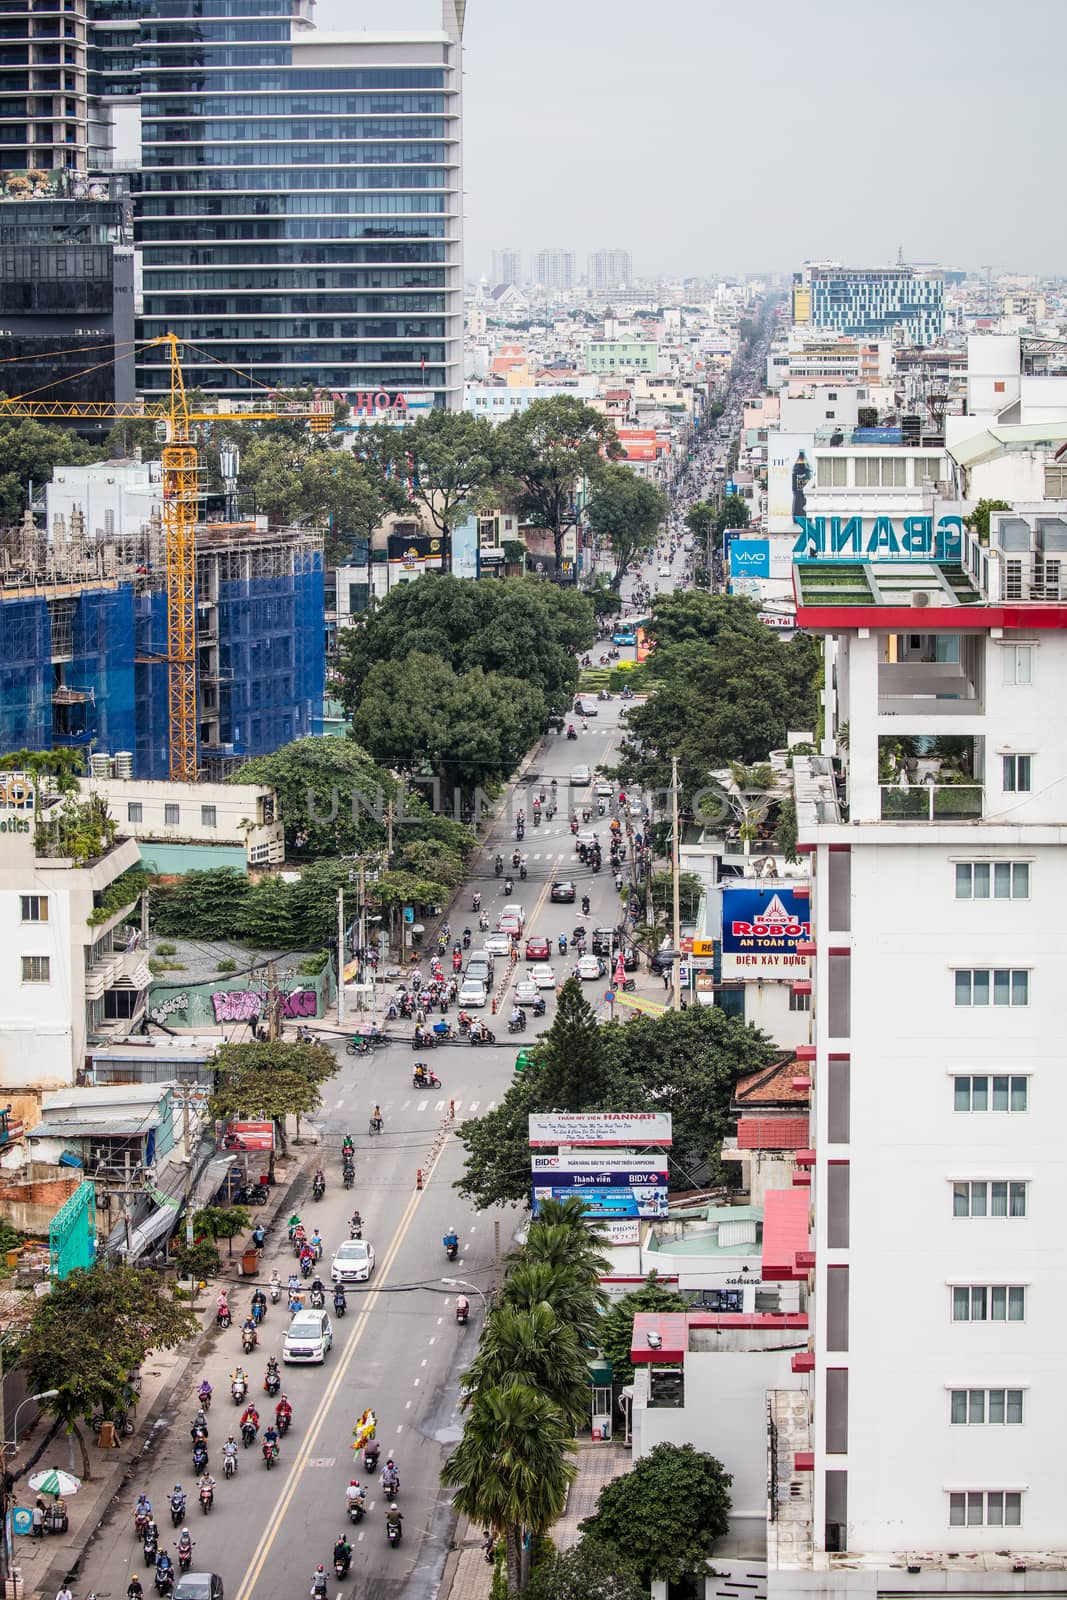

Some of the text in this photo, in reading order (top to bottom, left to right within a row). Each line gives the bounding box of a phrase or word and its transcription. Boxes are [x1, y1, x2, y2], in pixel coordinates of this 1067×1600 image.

[355, 386, 409, 410] HÒA
[735, 551, 766, 561] vivo
[740, 939, 754, 947] AN
[757, 937, 785, 947] TOÀN
[736, 954, 806, 967] ĐIỆN XÂY DỰNG
[535, 1158, 556, 1166] BIDC
[573, 1174, 611, 1183] Thành viên
[629, 1174, 648, 1182] BIDV
[725, 1275, 761, 1285] sakura
